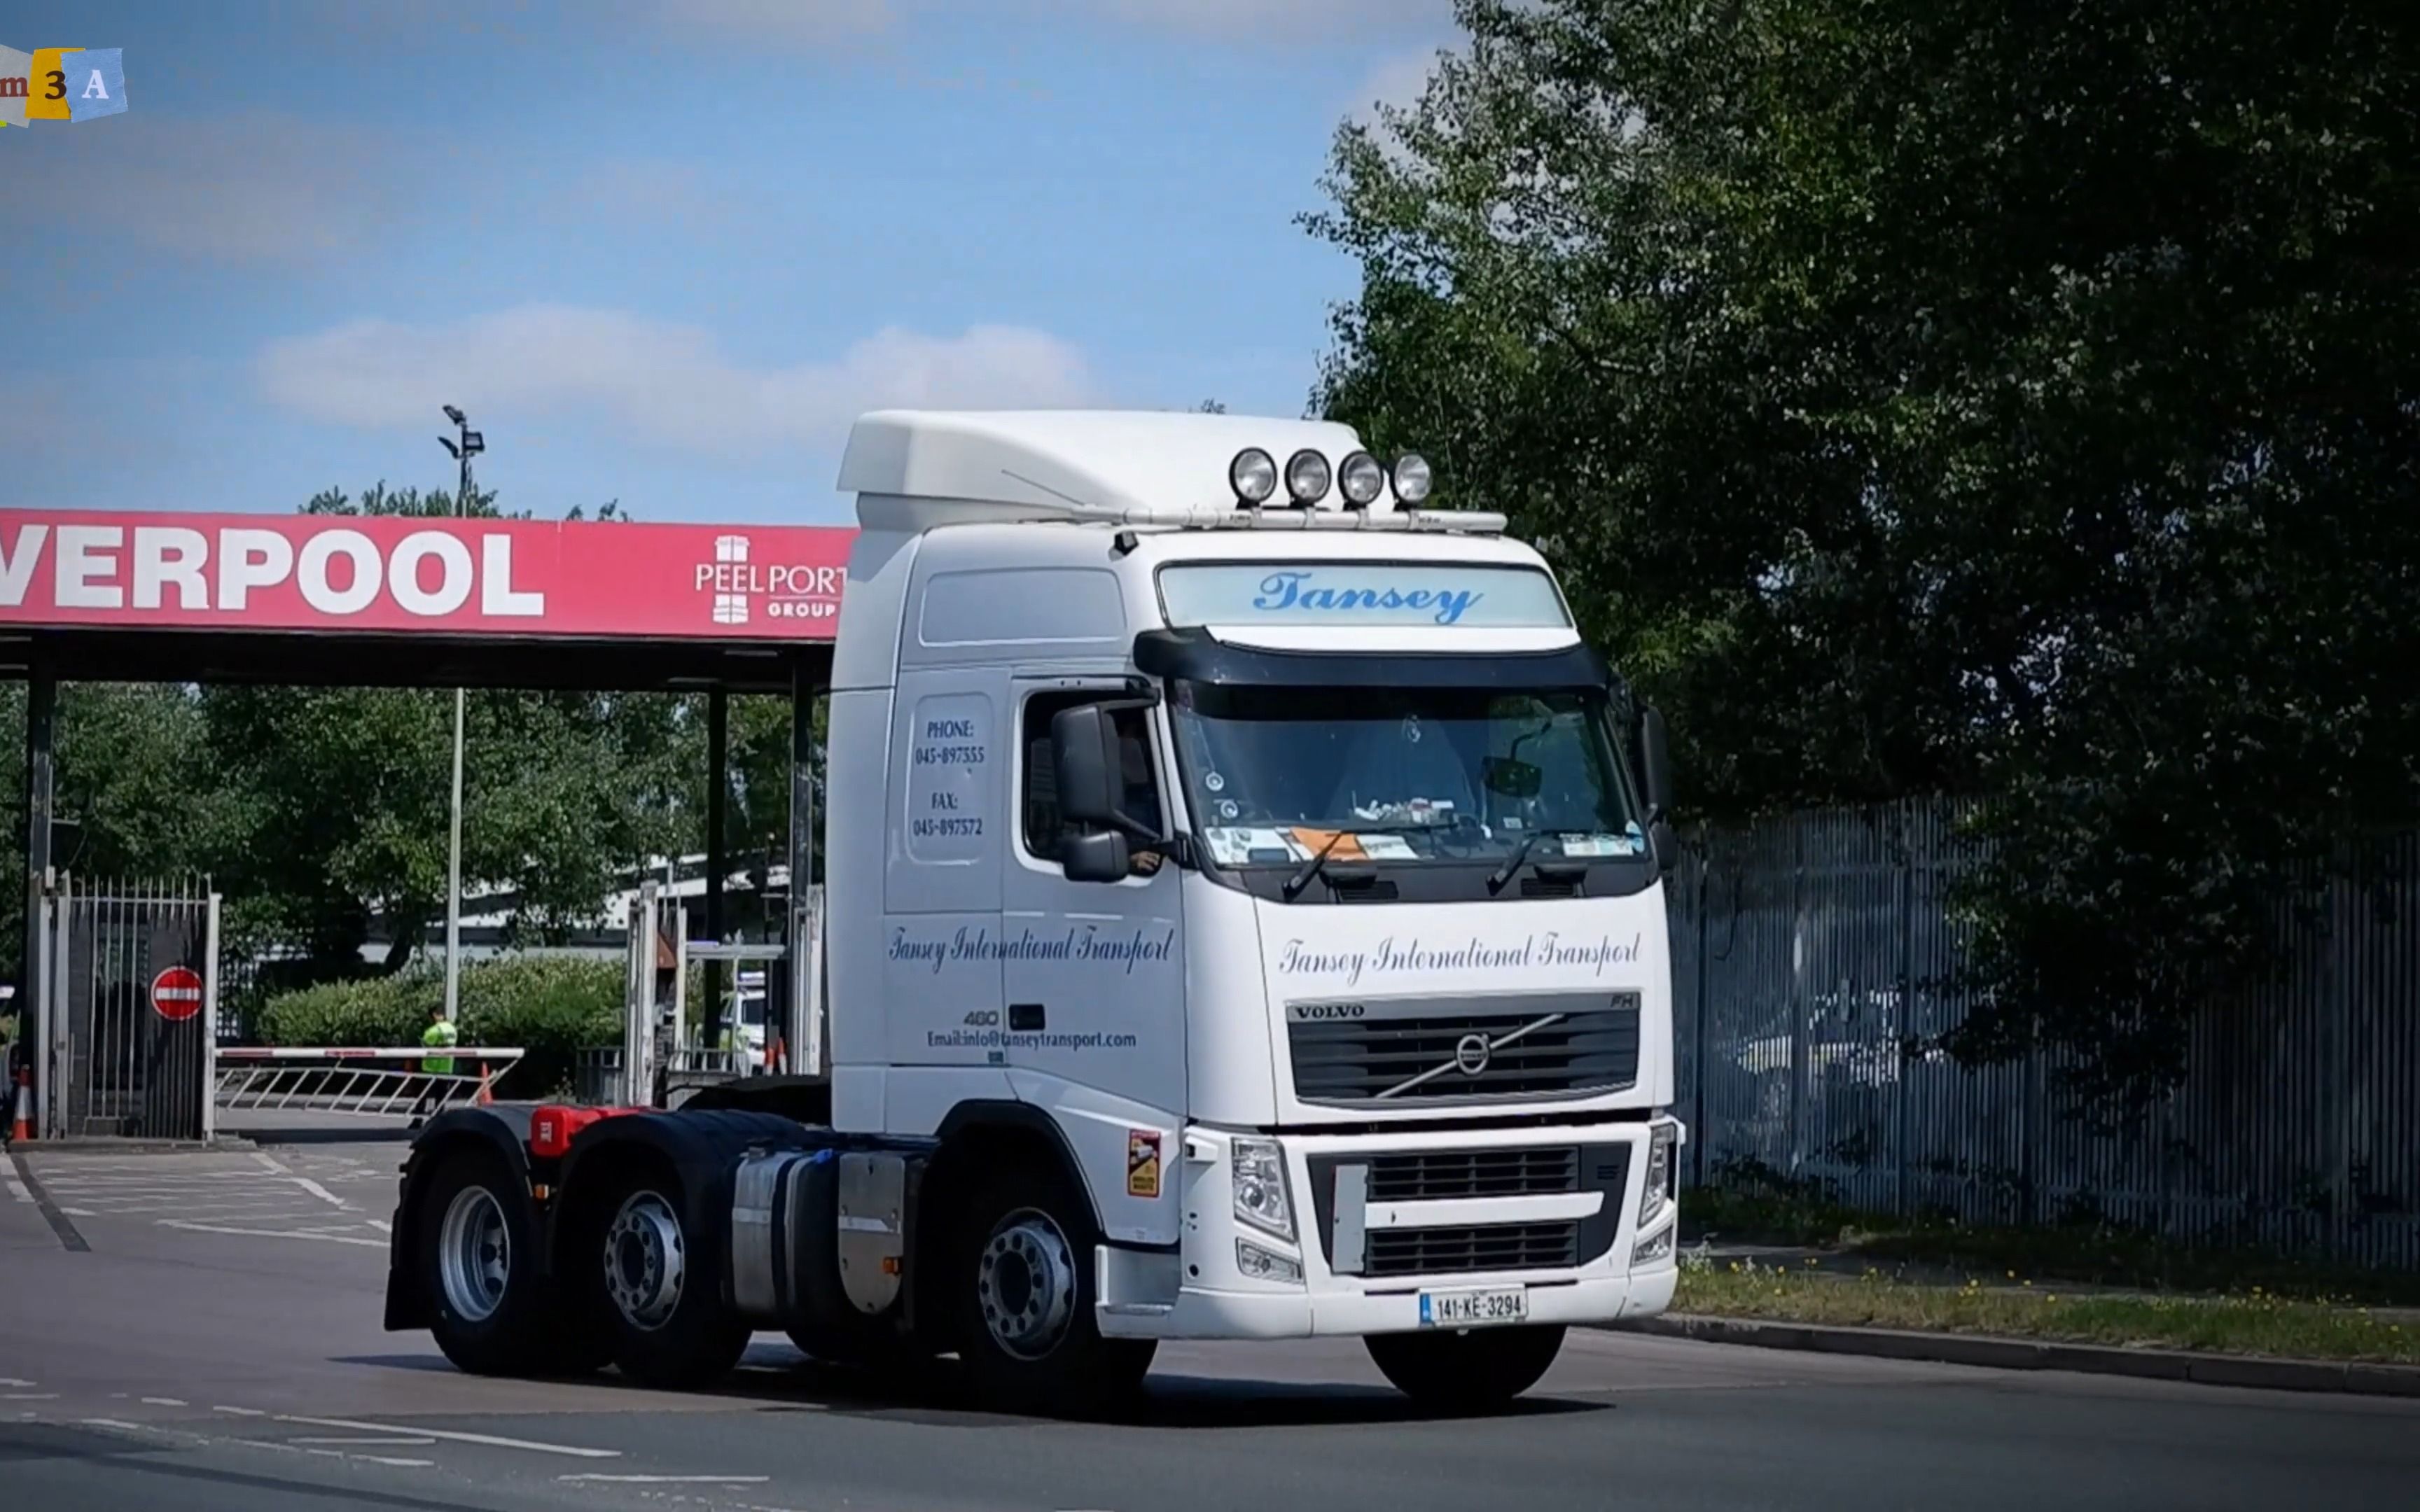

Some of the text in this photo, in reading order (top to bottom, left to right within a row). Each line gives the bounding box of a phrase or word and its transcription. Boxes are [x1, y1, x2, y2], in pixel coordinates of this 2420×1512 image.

[695, 564, 765, 592] PEEL
[1253, 571, 1484, 625] Tansey
[768, 602, 836, 617] GROUP
[927, 720, 974, 738] PHONE:
[915, 746, 985, 764] 045-897555
[931, 792, 958, 810] FAX:
[913, 818, 982, 836] 045-897572
[889, 925, 1174, 975] Tansey International Transport
[1279, 931, 1641, 988] Tansey International Transport
[1610, 995, 1634, 1008] FH
[1295, 1004, 1365, 1019] VOLVO
[1438, 1294, 1522, 1320] 141-KE-3294
